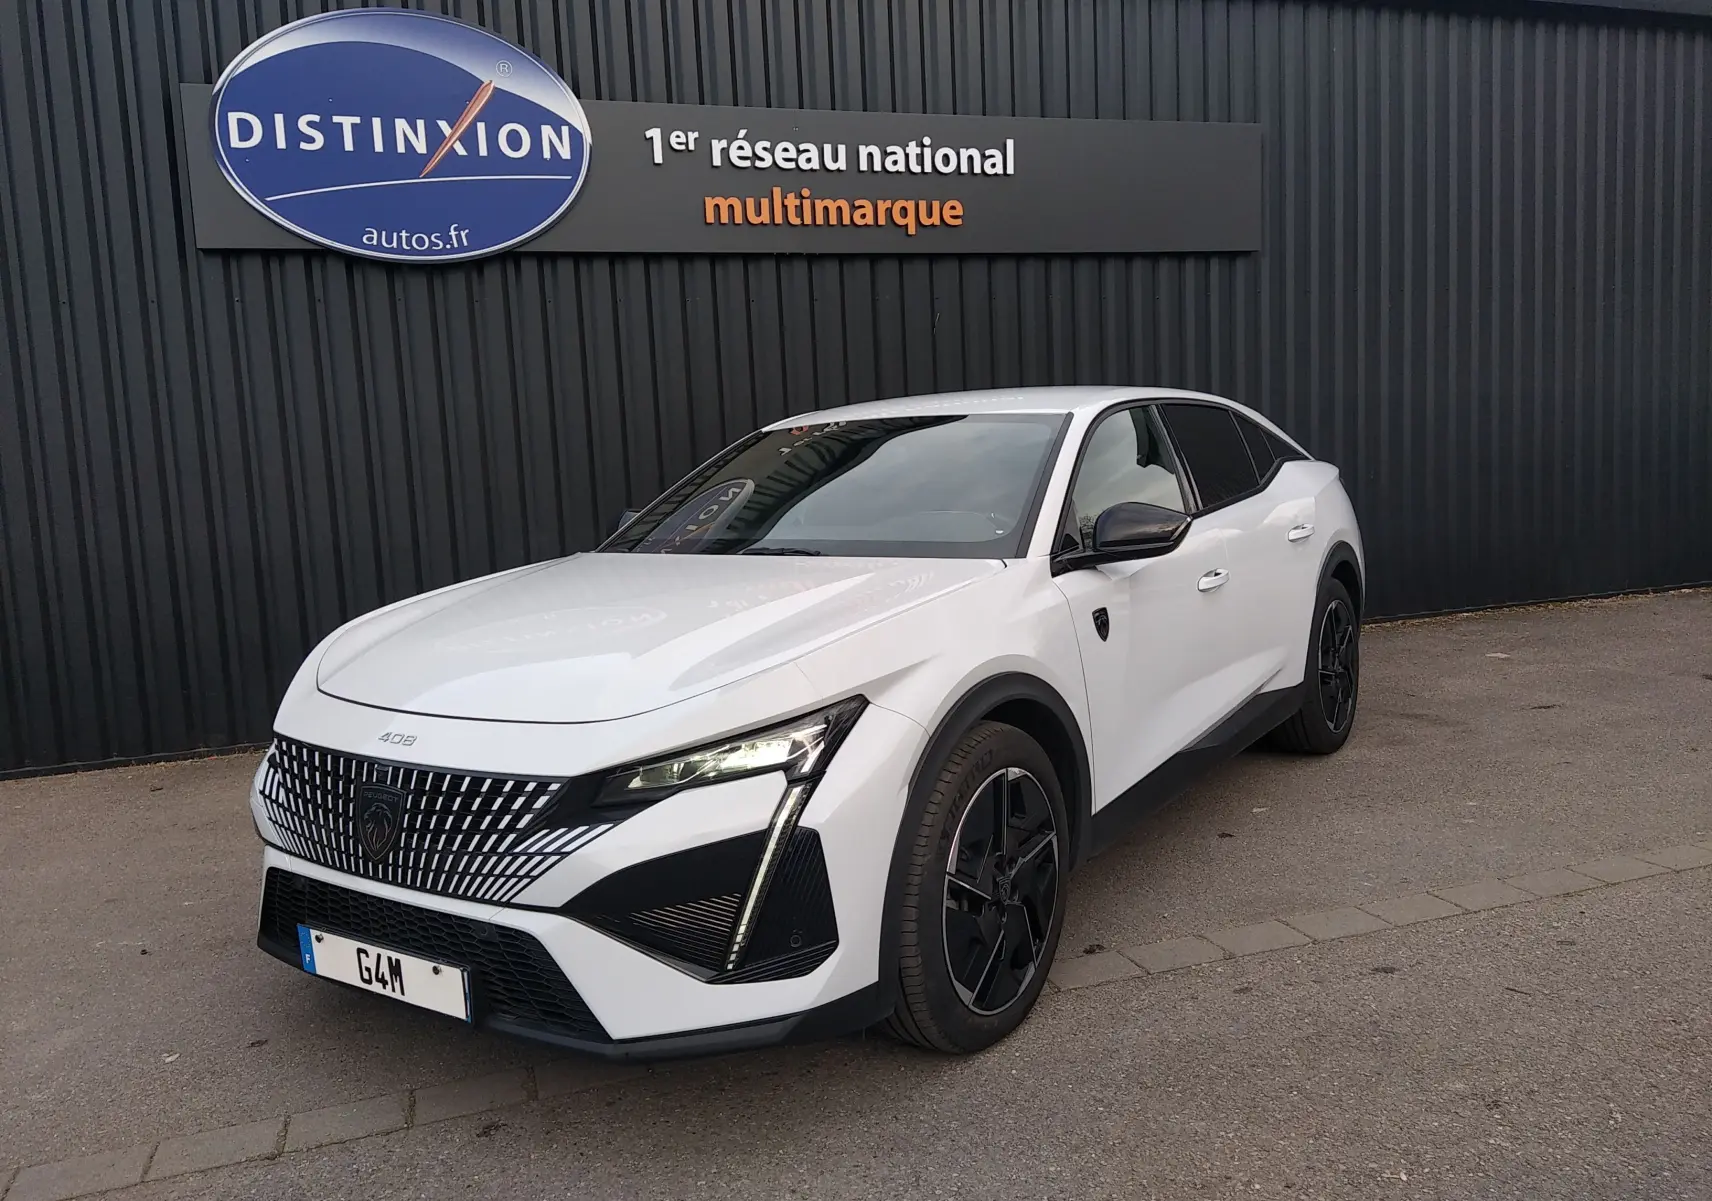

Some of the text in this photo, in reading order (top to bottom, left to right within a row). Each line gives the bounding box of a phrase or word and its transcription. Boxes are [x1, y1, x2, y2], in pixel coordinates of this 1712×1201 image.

[227, 111, 572, 161] DISTINXION
[710, 128, 847, 171] réseau
[858, 135, 1015, 175] national
[703, 186, 965, 236] multimarque
[362, 223, 470, 251] autos.fr
[378, 732, 417, 747] 408
[356, 947, 405, 996] G4M
